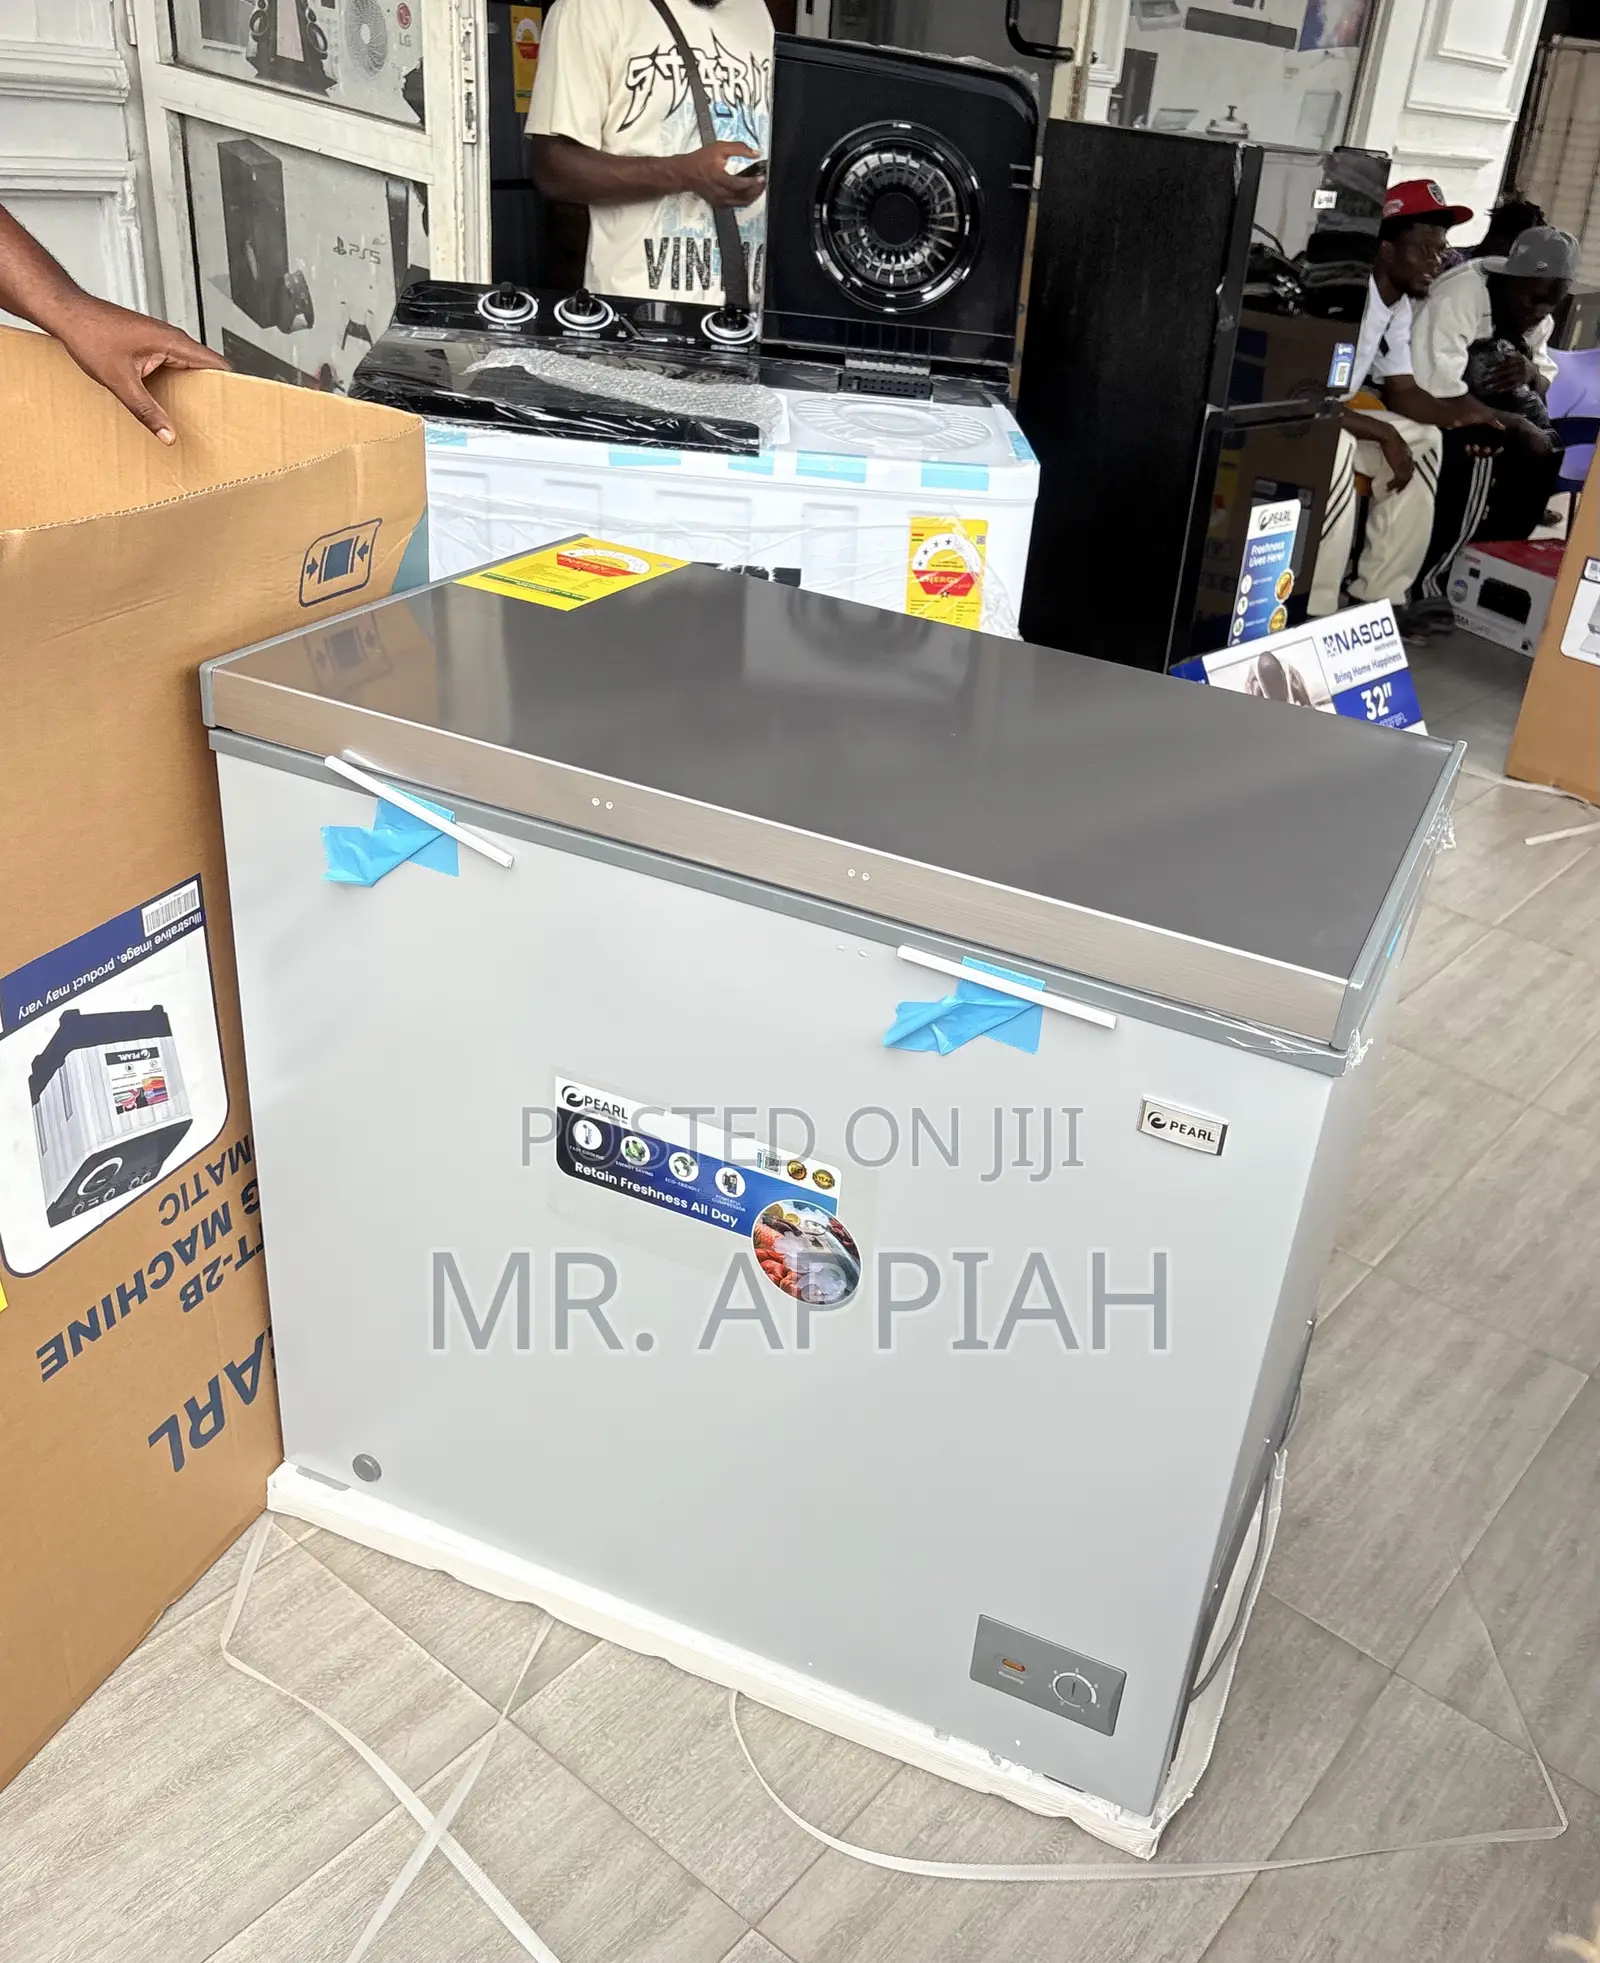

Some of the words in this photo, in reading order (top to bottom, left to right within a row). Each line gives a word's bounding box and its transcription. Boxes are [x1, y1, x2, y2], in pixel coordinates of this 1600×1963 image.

[399, 33, 411, 47] LG
[349, 243, 381, 264] PS5
[1334, 616, 1394, 654] NASCO
[1333, 670, 1353, 684] Bring
[1352, 662, 1371, 678] Home
[1371, 652, 1402, 671] Happiness
[1360, 682, 1392, 721] 32"
[154, 910, 203, 944] Illustrative
[117, 938, 153, 966] image,
[72, 957, 115, 991] product
[46, 983, 71, 1005] may
[18, 999, 43, 1021] vary
[584, 1095, 629, 1120] PEARL
[1169, 1120, 1216, 1143] PEARL
[635, 1166, 654, 1178] SAVING
[664, 1177, 701, 1192] ECO-FRIENDLY
[575, 1162, 618, 1185] Retain
[620, 1176, 688, 1209] Freshness
[691, 1201, 708, 1216] All
[711, 1207, 739, 1228] Day
[36, 1200, 234, 1384] MACHINE
[148, 1324, 277, 1473] ARL
